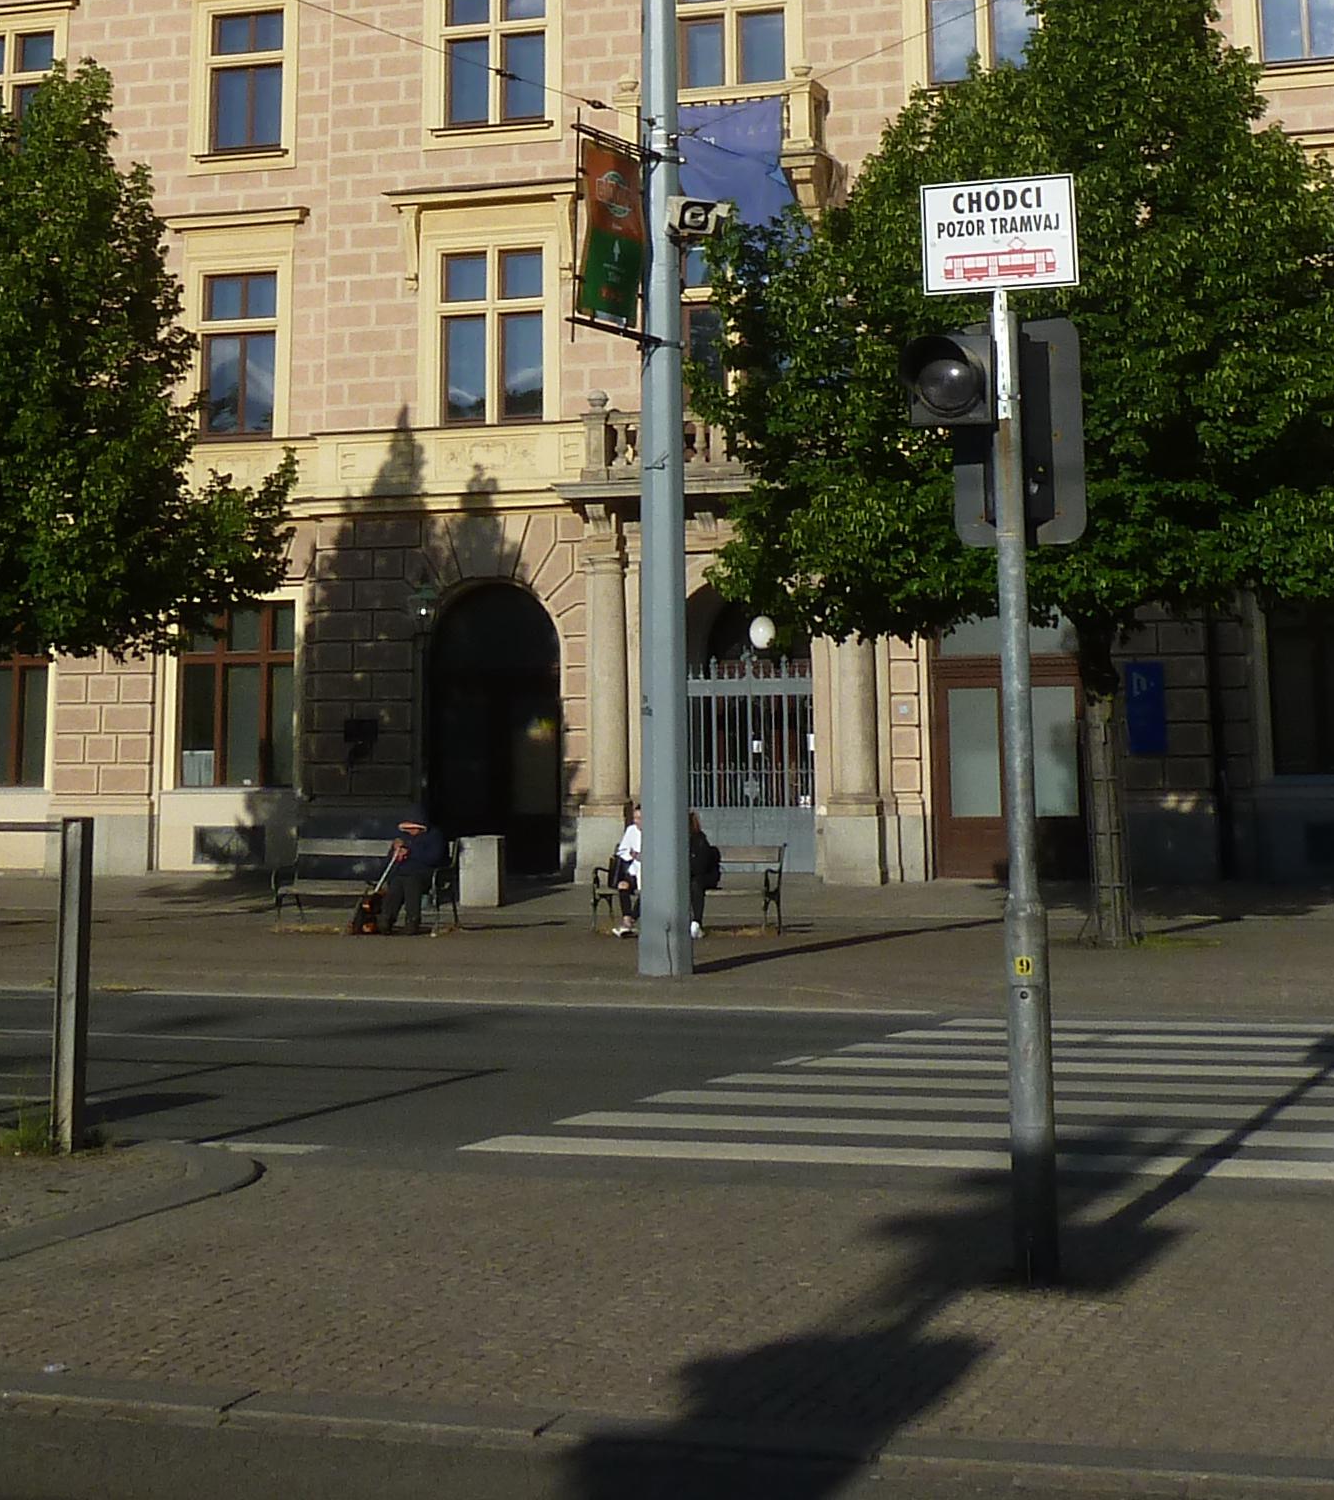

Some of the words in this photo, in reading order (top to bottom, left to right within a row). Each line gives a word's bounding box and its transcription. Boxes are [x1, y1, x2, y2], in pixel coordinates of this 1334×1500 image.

[952, 186, 1042, 214] CHODCI
[937, 218, 985, 239] POZOR
[991, 213, 1060, 235] TRAMVAJ
[1019, 958, 1030, 973] 9
